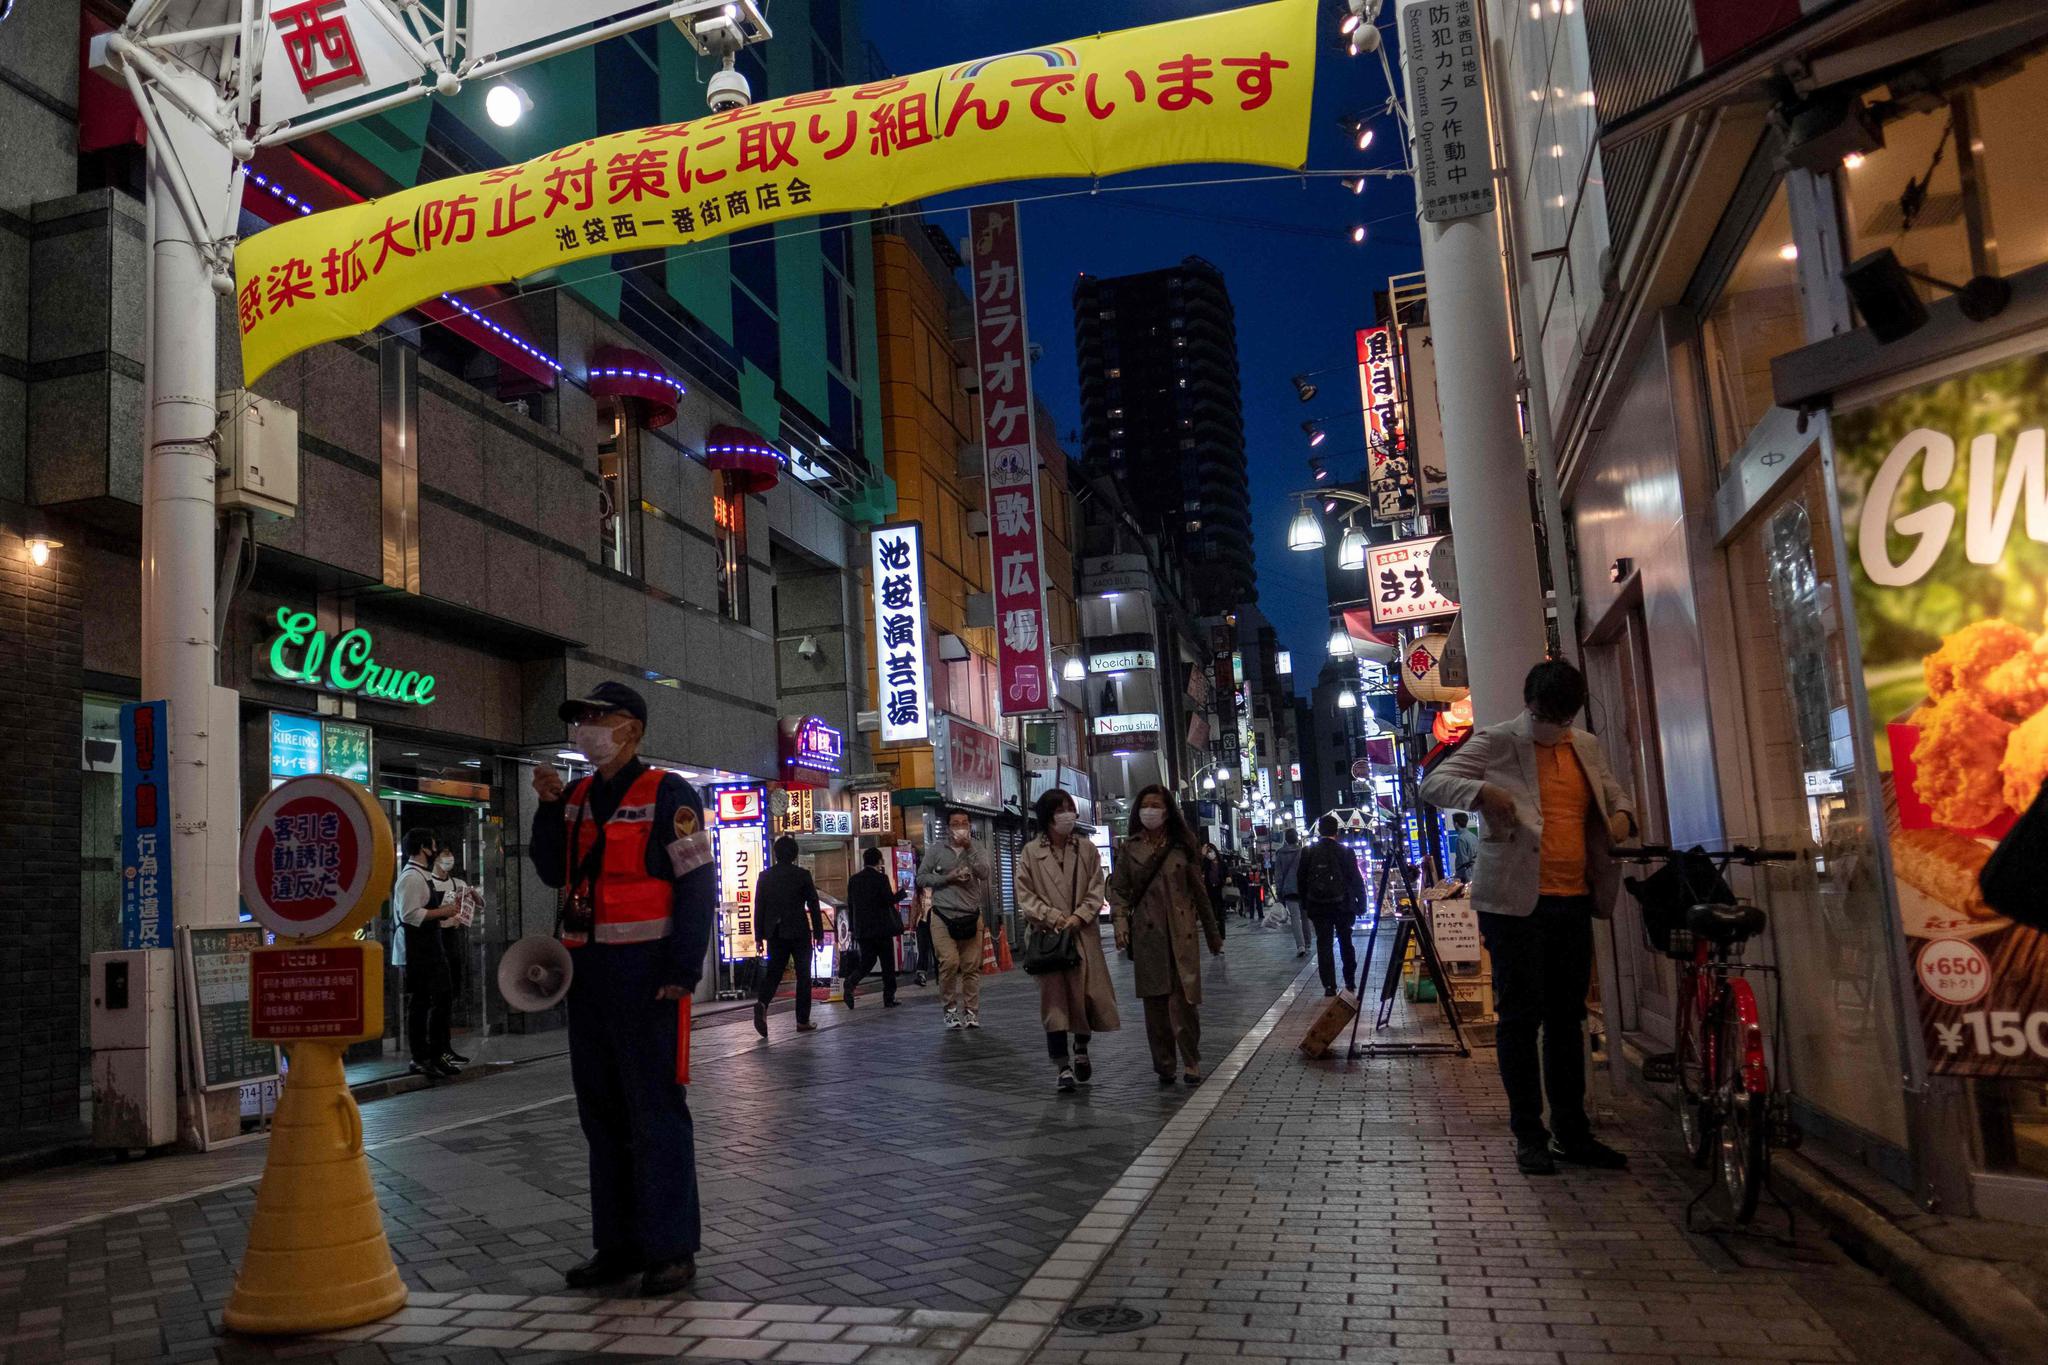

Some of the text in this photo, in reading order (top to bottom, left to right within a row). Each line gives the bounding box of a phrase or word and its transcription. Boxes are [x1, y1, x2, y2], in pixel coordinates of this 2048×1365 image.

[270, 0, 365, 95] 西
[1455, 0, 1478, 88] 池袋西口地区
[1410, 8, 1437, 188] Security Camera Operating
[1429, 4, 1468, 185] 防犯カメラ作動中
[239, 50, 1290, 336] 感染拡大防止対策に取り組んでいます
[554, 175, 812, 252] 池袋西一番街商店会
[980, 260, 1039, 654] カラオケ 歌広場
[1380, 564, 1439, 603] ます
[270, 606, 437, 705] El Cruce
[878, 534, 920, 727] 池袋演芸場
[1410, 649, 1431, 672] 魚
[273, 731, 319, 749] KIREIMO
[1099, 718, 1134, 733] Nomu
[273, 843, 340, 872] 勧誘は
[274, 812, 339, 842] 客引き
[272, 873, 339, 902] 違反だ
[1923, 956, 1983, 976] ¥650
